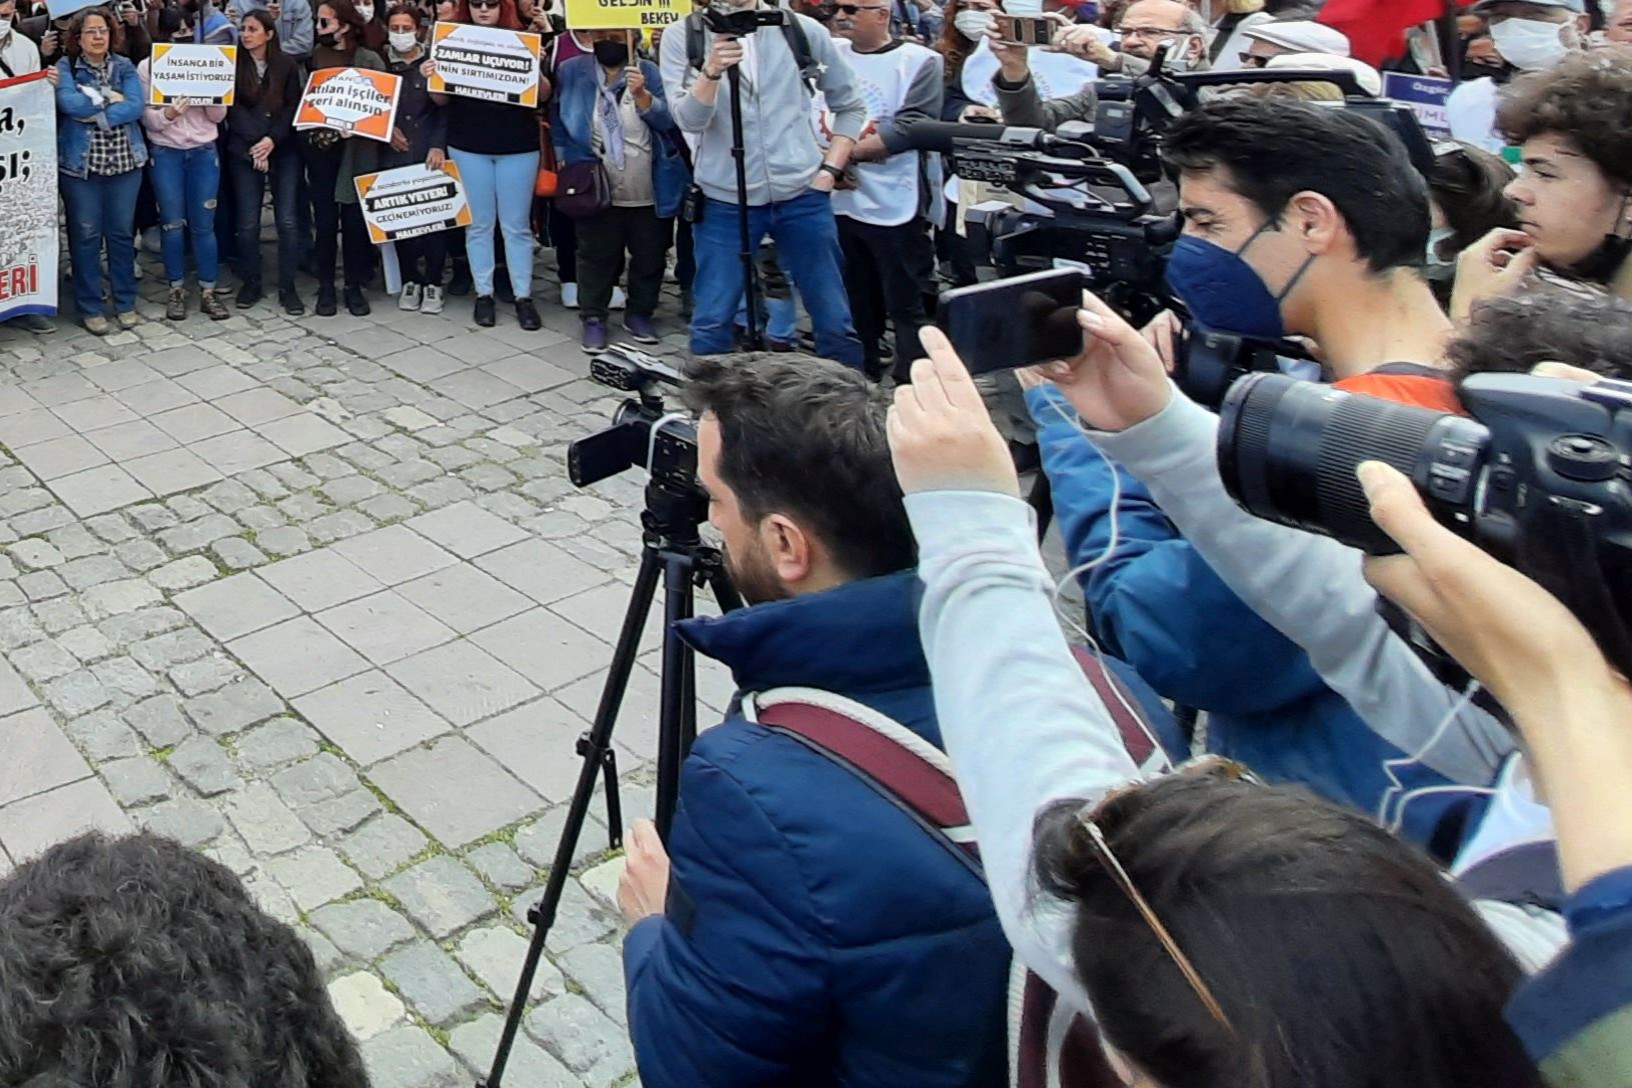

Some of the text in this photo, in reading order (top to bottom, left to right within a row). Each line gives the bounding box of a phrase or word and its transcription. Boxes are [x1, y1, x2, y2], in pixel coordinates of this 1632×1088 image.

[641, 12, 679, 25] BEKEV
[167, 56, 224, 68] İNSANCA BİR
[437, 48, 529, 71] ZAMLAR UÇUYOR!
[153, 72, 185, 82] YAŞAM
[348, 84, 391, 104] işçiler
[335, 98, 383, 116] alınsın
[373, 186, 448, 210] ARTIK YETER!
